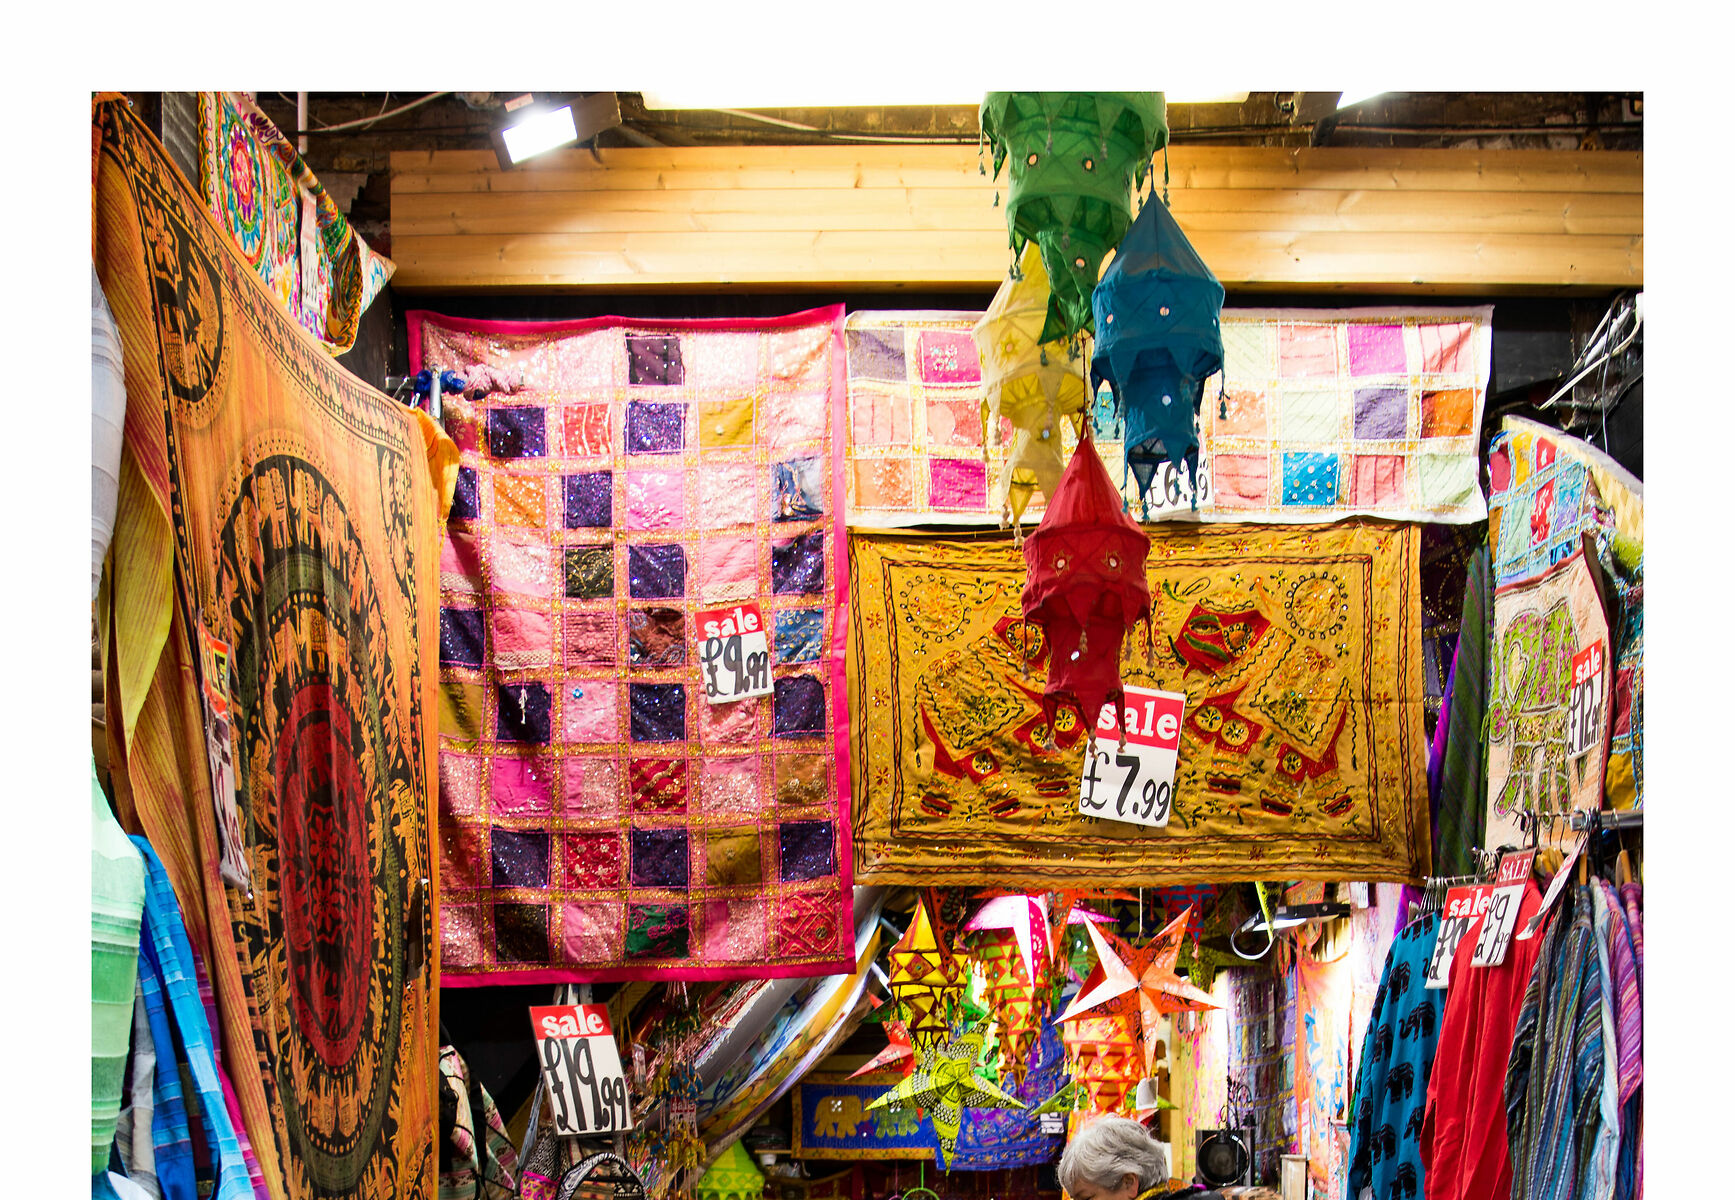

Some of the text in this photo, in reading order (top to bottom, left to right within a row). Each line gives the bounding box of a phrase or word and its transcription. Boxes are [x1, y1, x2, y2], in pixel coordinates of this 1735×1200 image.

[704, 607, 758, 638] sale
[1575, 646, 1600, 684] sale
[1097, 700, 1178, 741] sale
[1081, 751, 1171, 822] £7.99
[1500, 858, 1531, 882] SALE
[541, 1004, 604, 1037] sale
[543, 1036, 627, 1133] £19.99
